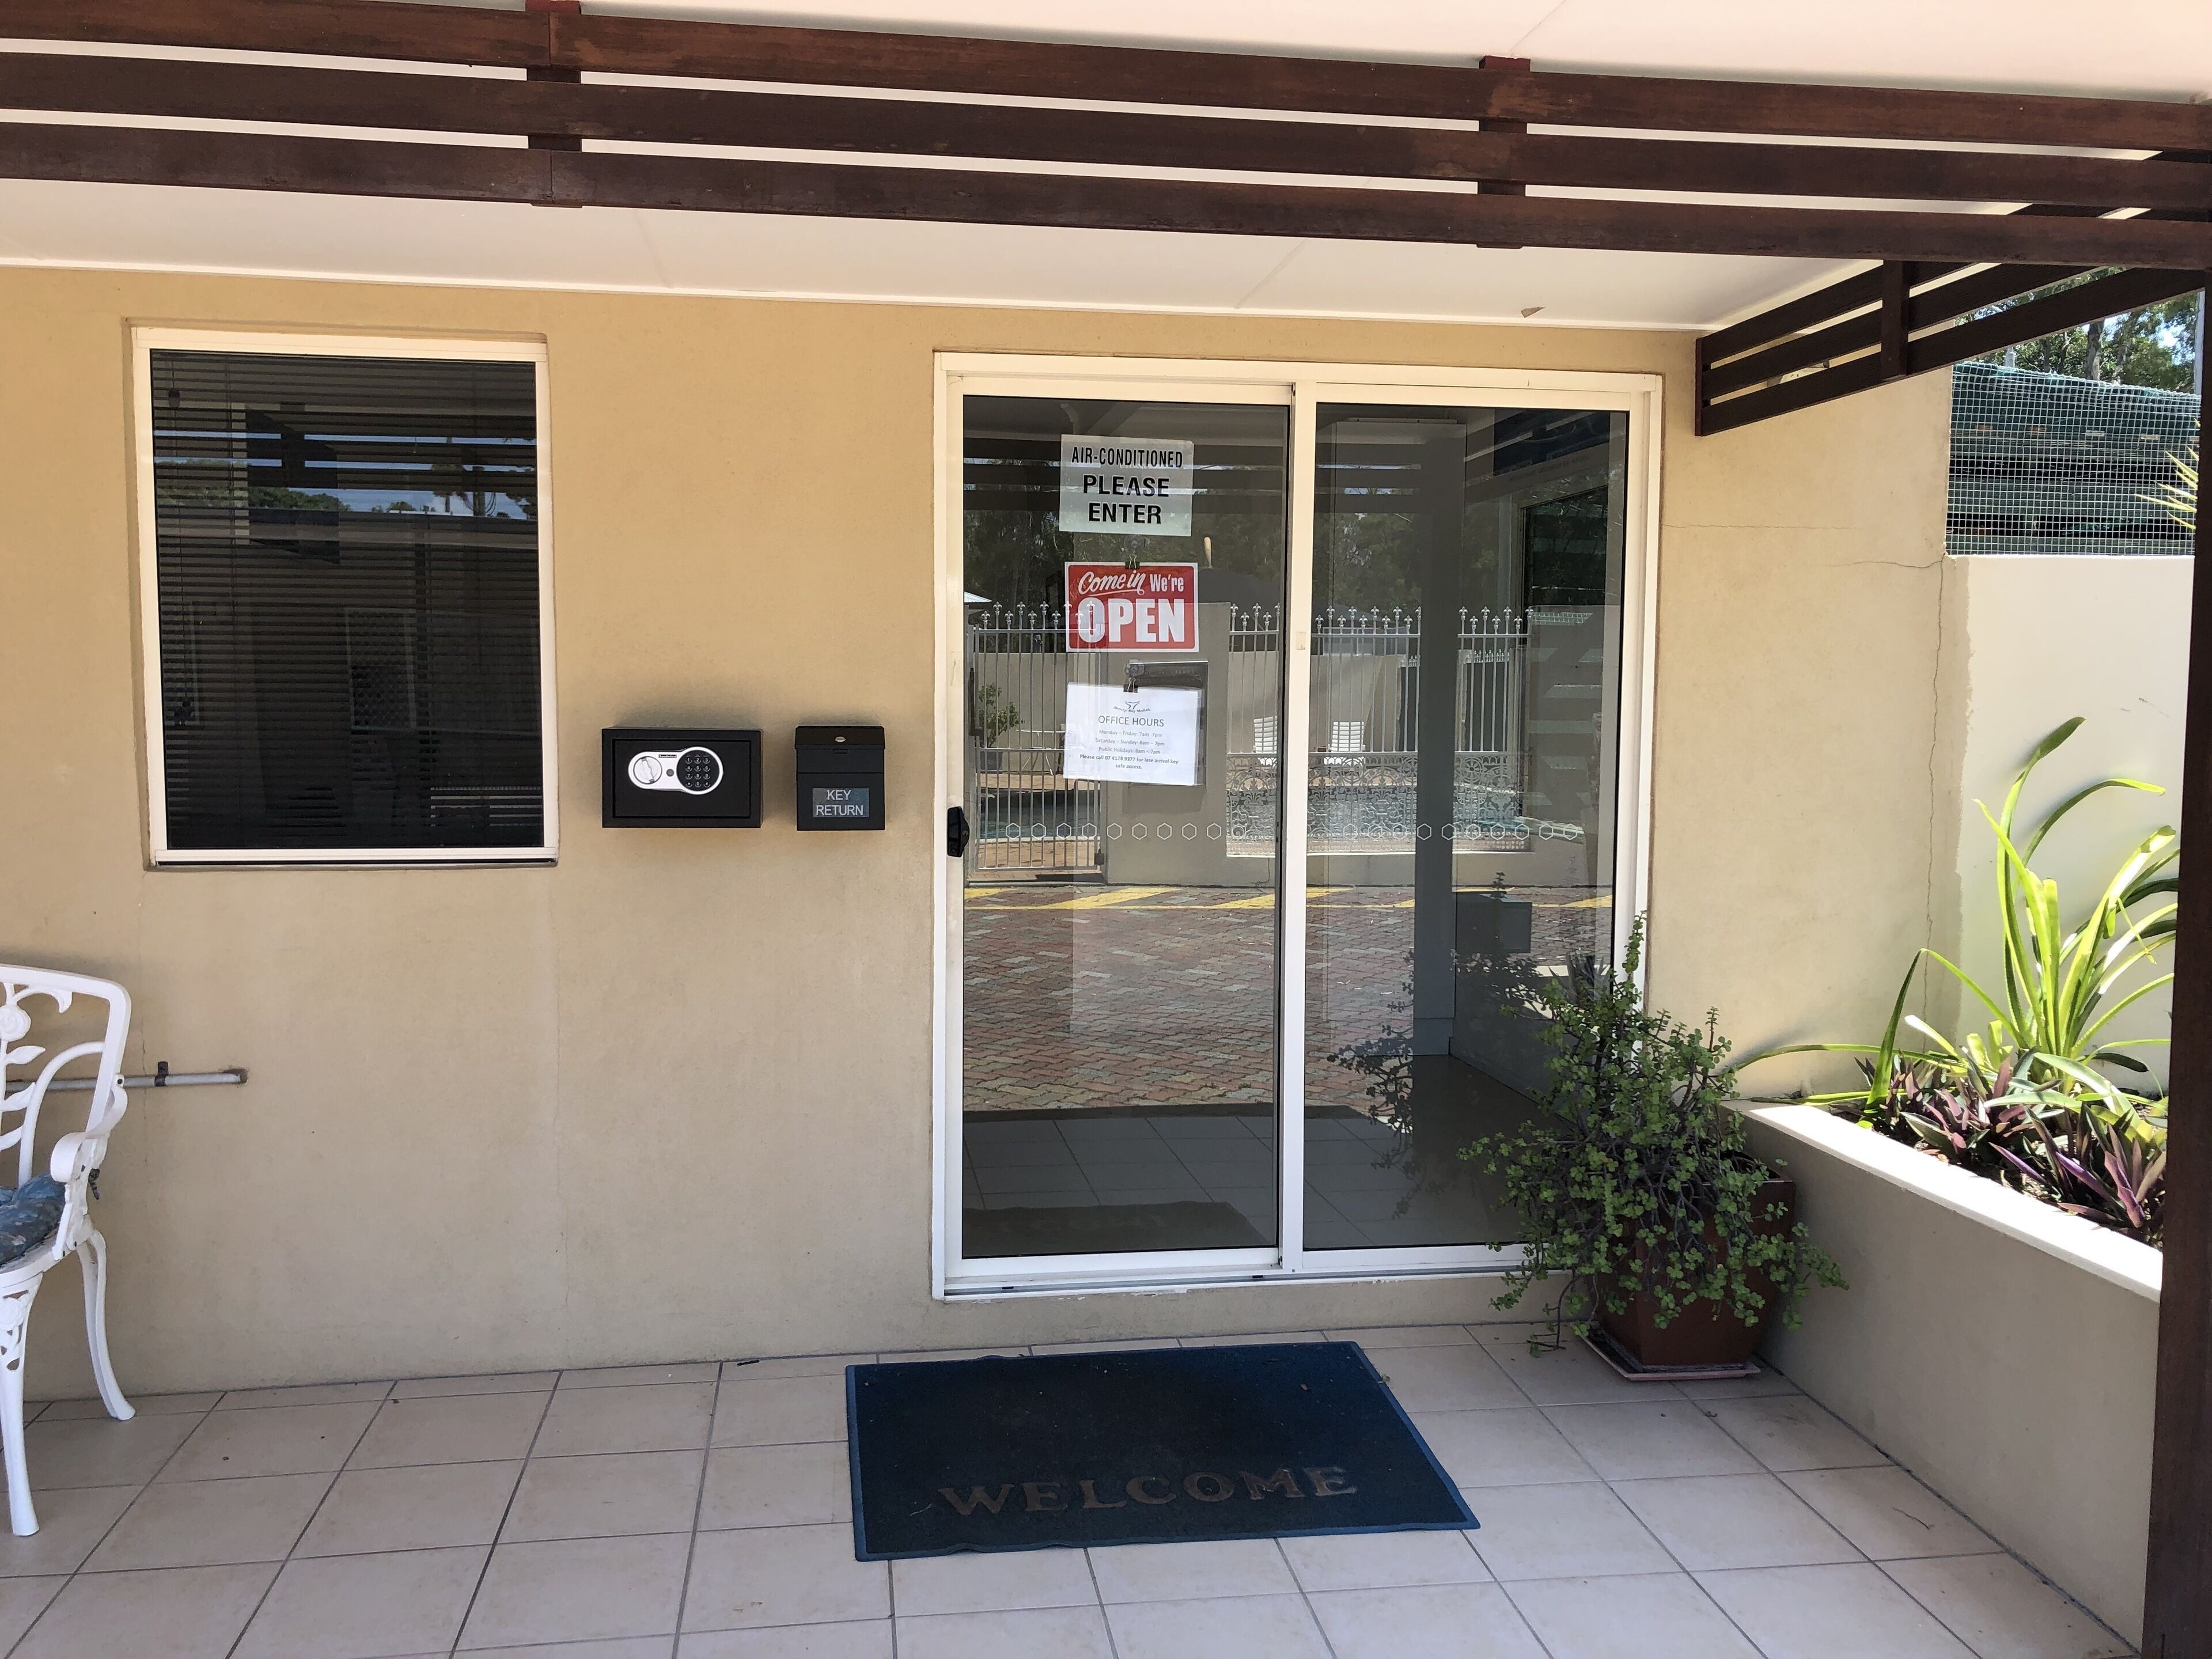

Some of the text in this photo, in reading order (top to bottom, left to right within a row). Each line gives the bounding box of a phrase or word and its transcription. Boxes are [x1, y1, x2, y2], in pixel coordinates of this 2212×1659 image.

[1071, 446, 1183, 468] AIR-CONDITIONED
[1083, 474, 1169, 497] PLEASE
[1089, 502, 1161, 524] ENTER
[1078, 570, 1184, 595] Come in We're
[1078, 597, 1185, 643] OPEN
[1098, 715, 1164, 727] OFFICE HOURS
[827, 789, 851, 800] KEY
[816, 805, 863, 816] RETURN
[938, 1467, 1358, 1516] WELCOME
